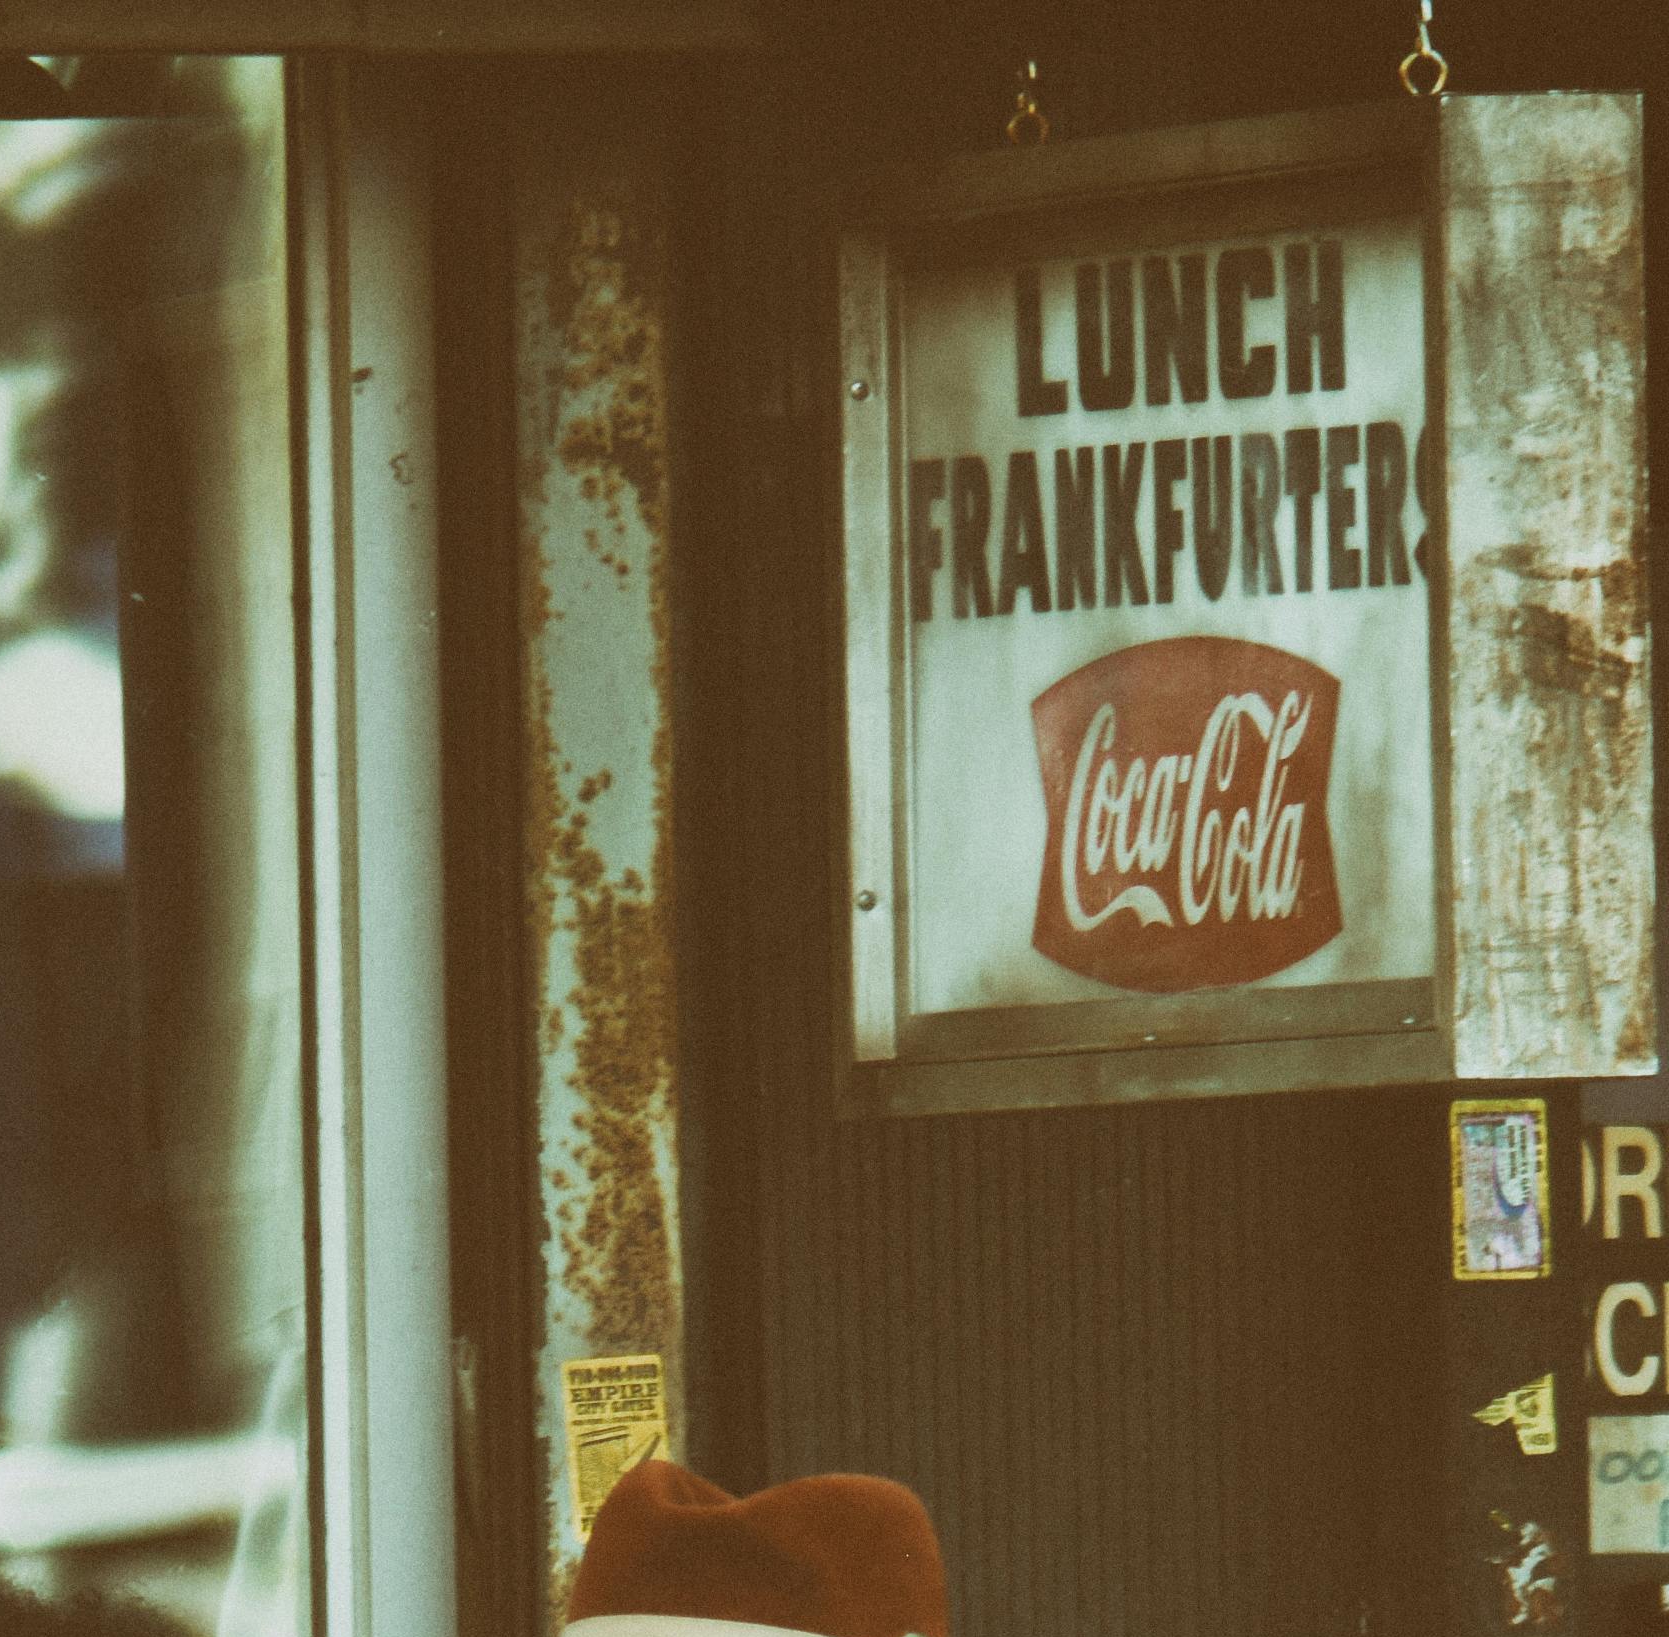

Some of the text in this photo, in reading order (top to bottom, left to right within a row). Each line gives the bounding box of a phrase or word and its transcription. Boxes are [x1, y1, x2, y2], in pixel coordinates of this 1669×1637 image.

[1014, 238, 1346, 418] LUNCH
[1062, 690, 1312, 932] Coca-Cola
[570, 1383, 659, 1403] EMPIRE
